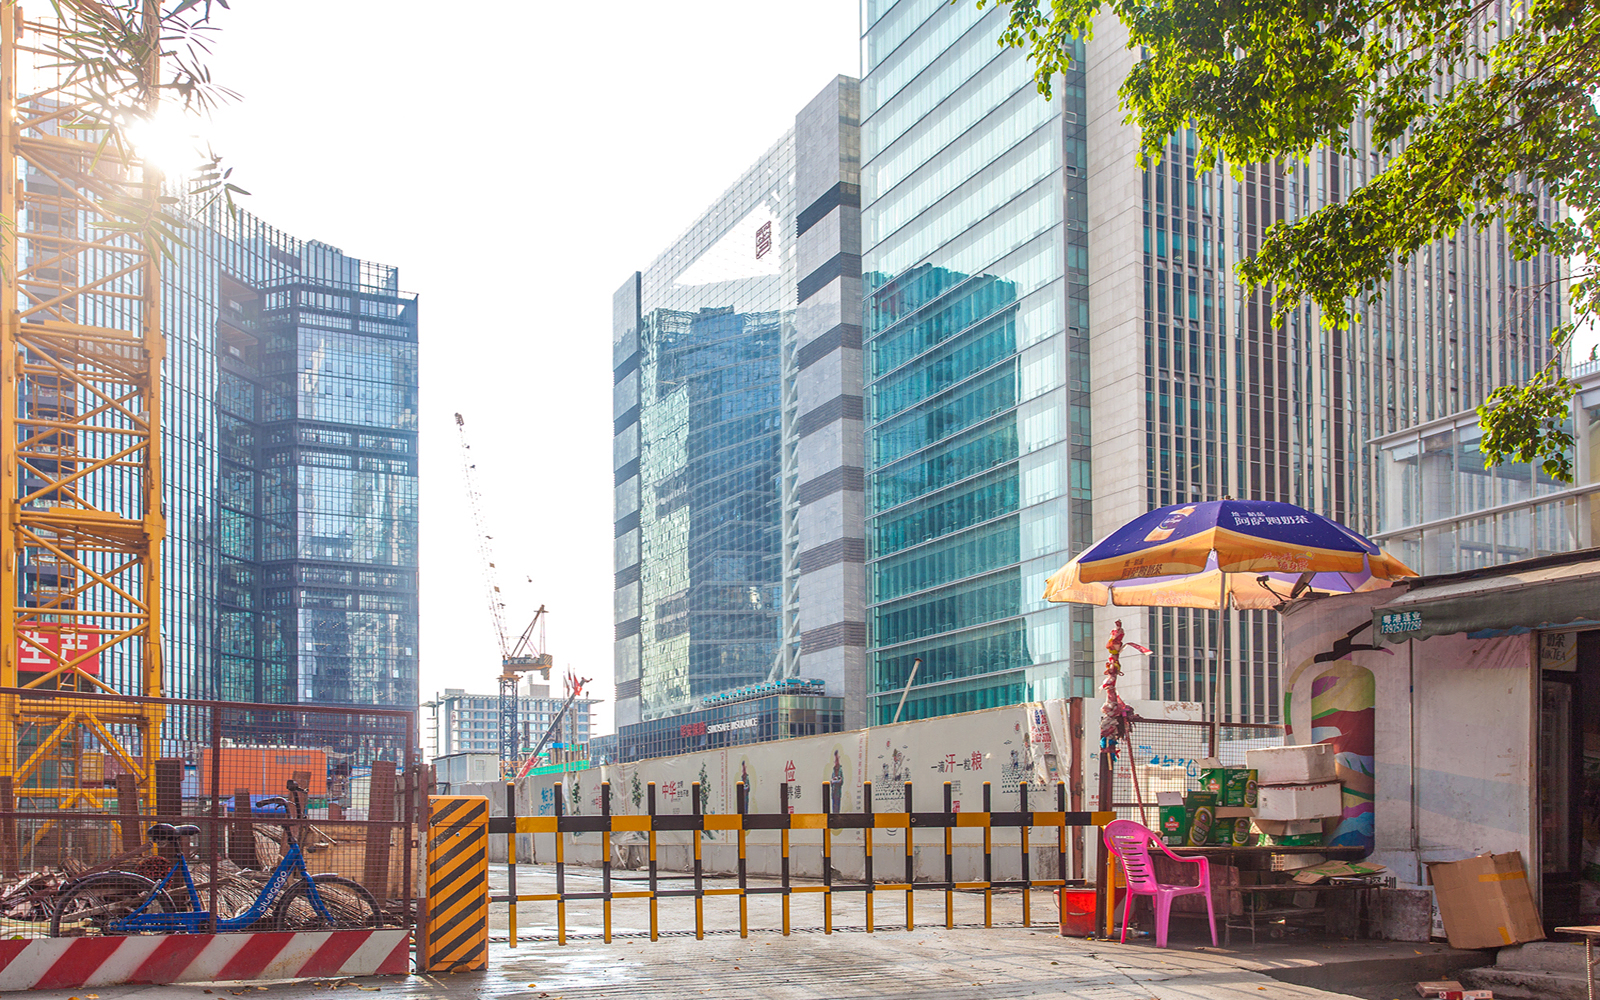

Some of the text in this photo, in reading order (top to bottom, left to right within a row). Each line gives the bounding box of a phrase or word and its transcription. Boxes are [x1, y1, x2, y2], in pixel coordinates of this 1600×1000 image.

[1234, 515, 1311, 526] 阿萨姆奶茶
[20, 630, 89, 666] 生产
[1543, 633, 1565, 647] 奶茶
[931, 750, 982, 773] 一滴汗一粒粮
[257, 871, 287, 912] bluegogo
